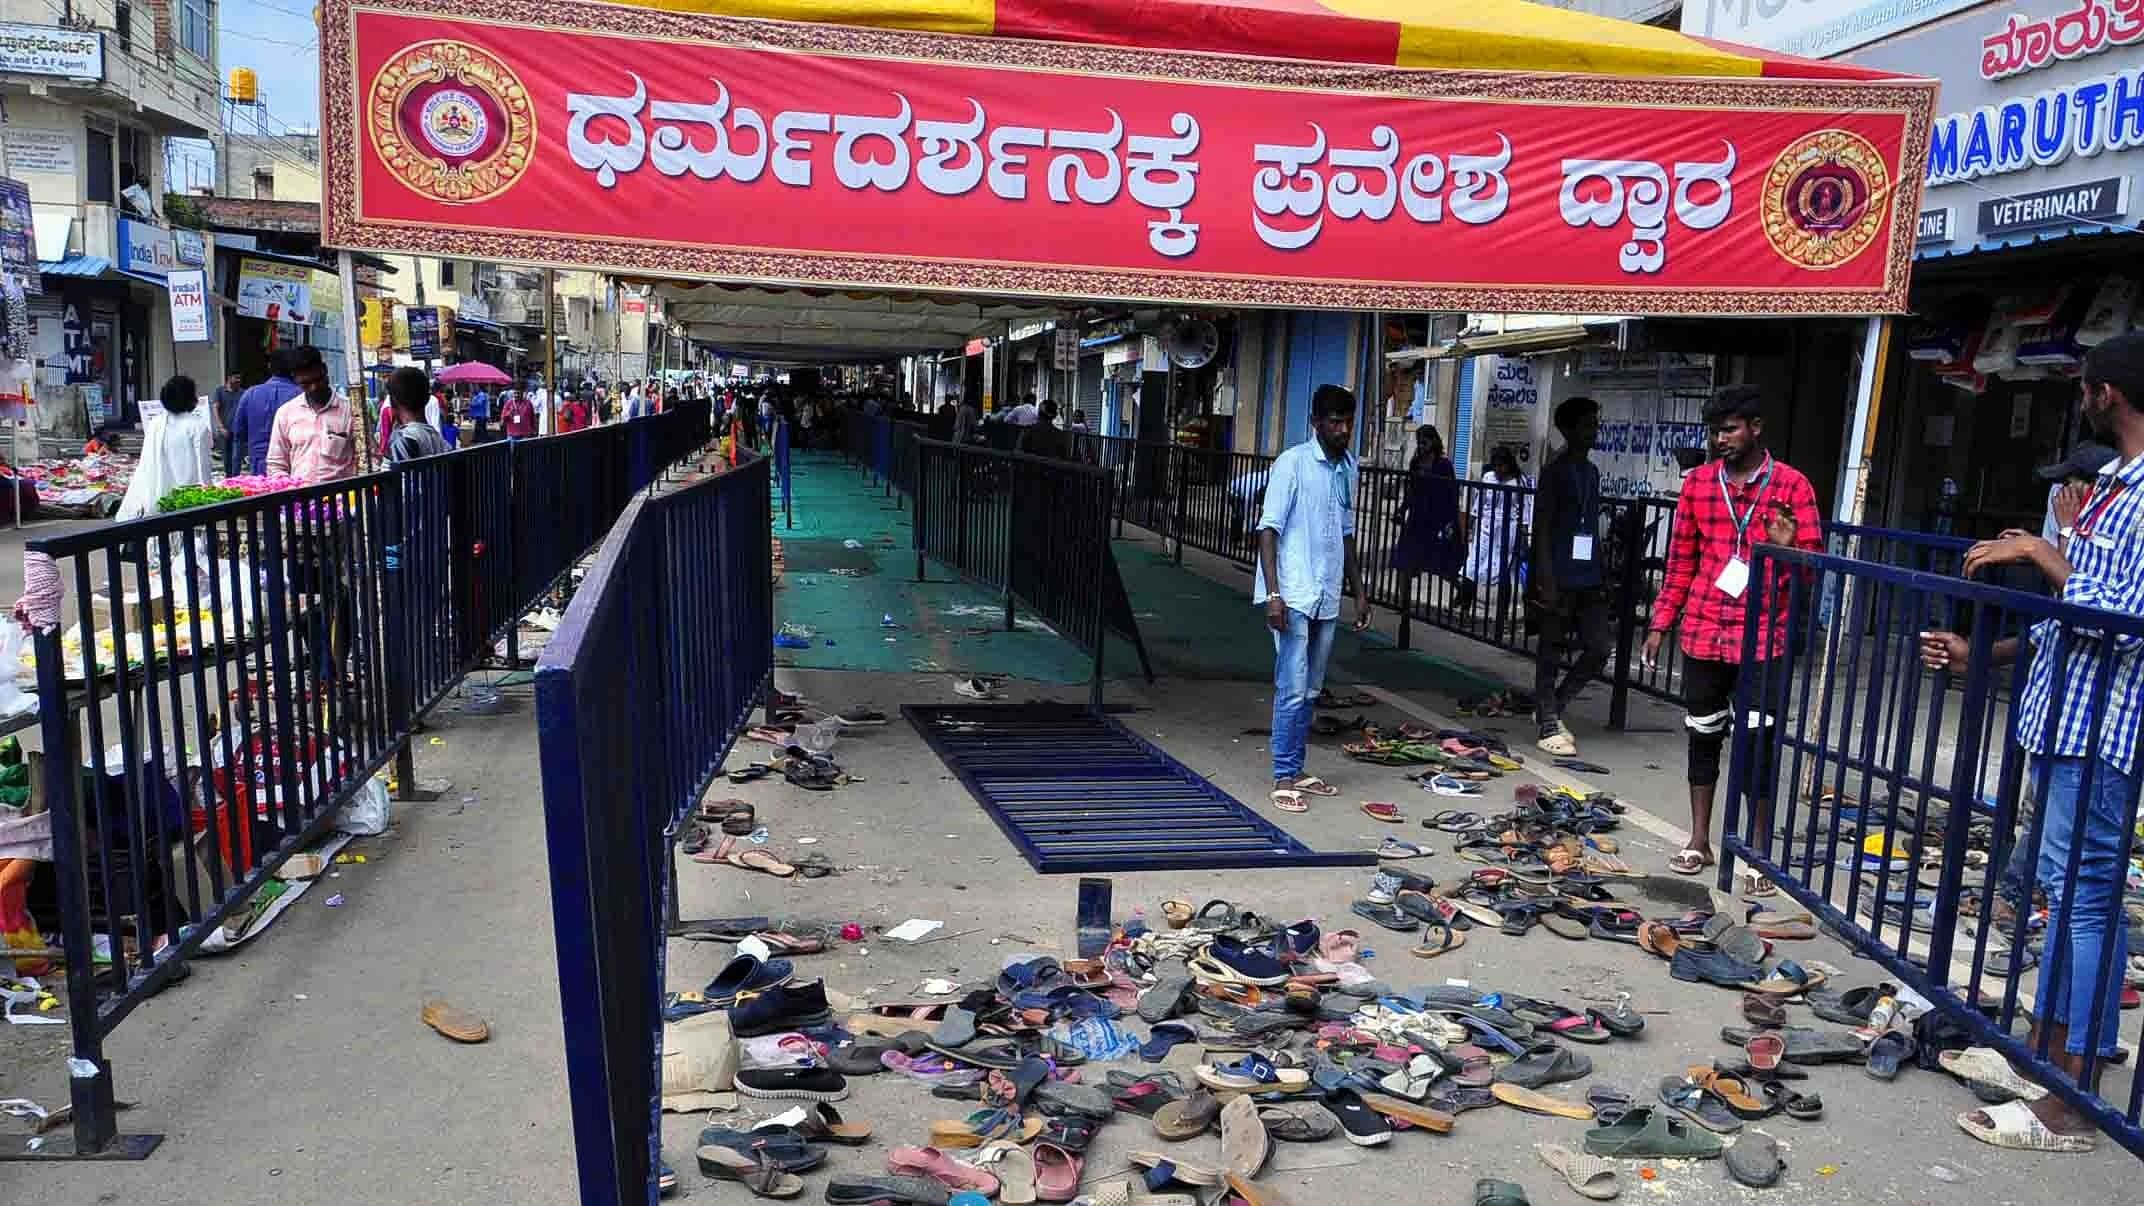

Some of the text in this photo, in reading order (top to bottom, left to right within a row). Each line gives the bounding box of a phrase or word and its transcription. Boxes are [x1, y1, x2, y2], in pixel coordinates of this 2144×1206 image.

[566, 71, 1737, 274] ಧರ್ಮದರ್ಶನಕ್ಕೆ ಪ್ರವೇಶ ದ್ವಾರ
[1993, 187, 2102, 226] VETERINARY
[174, 293, 202, 307] ATM
